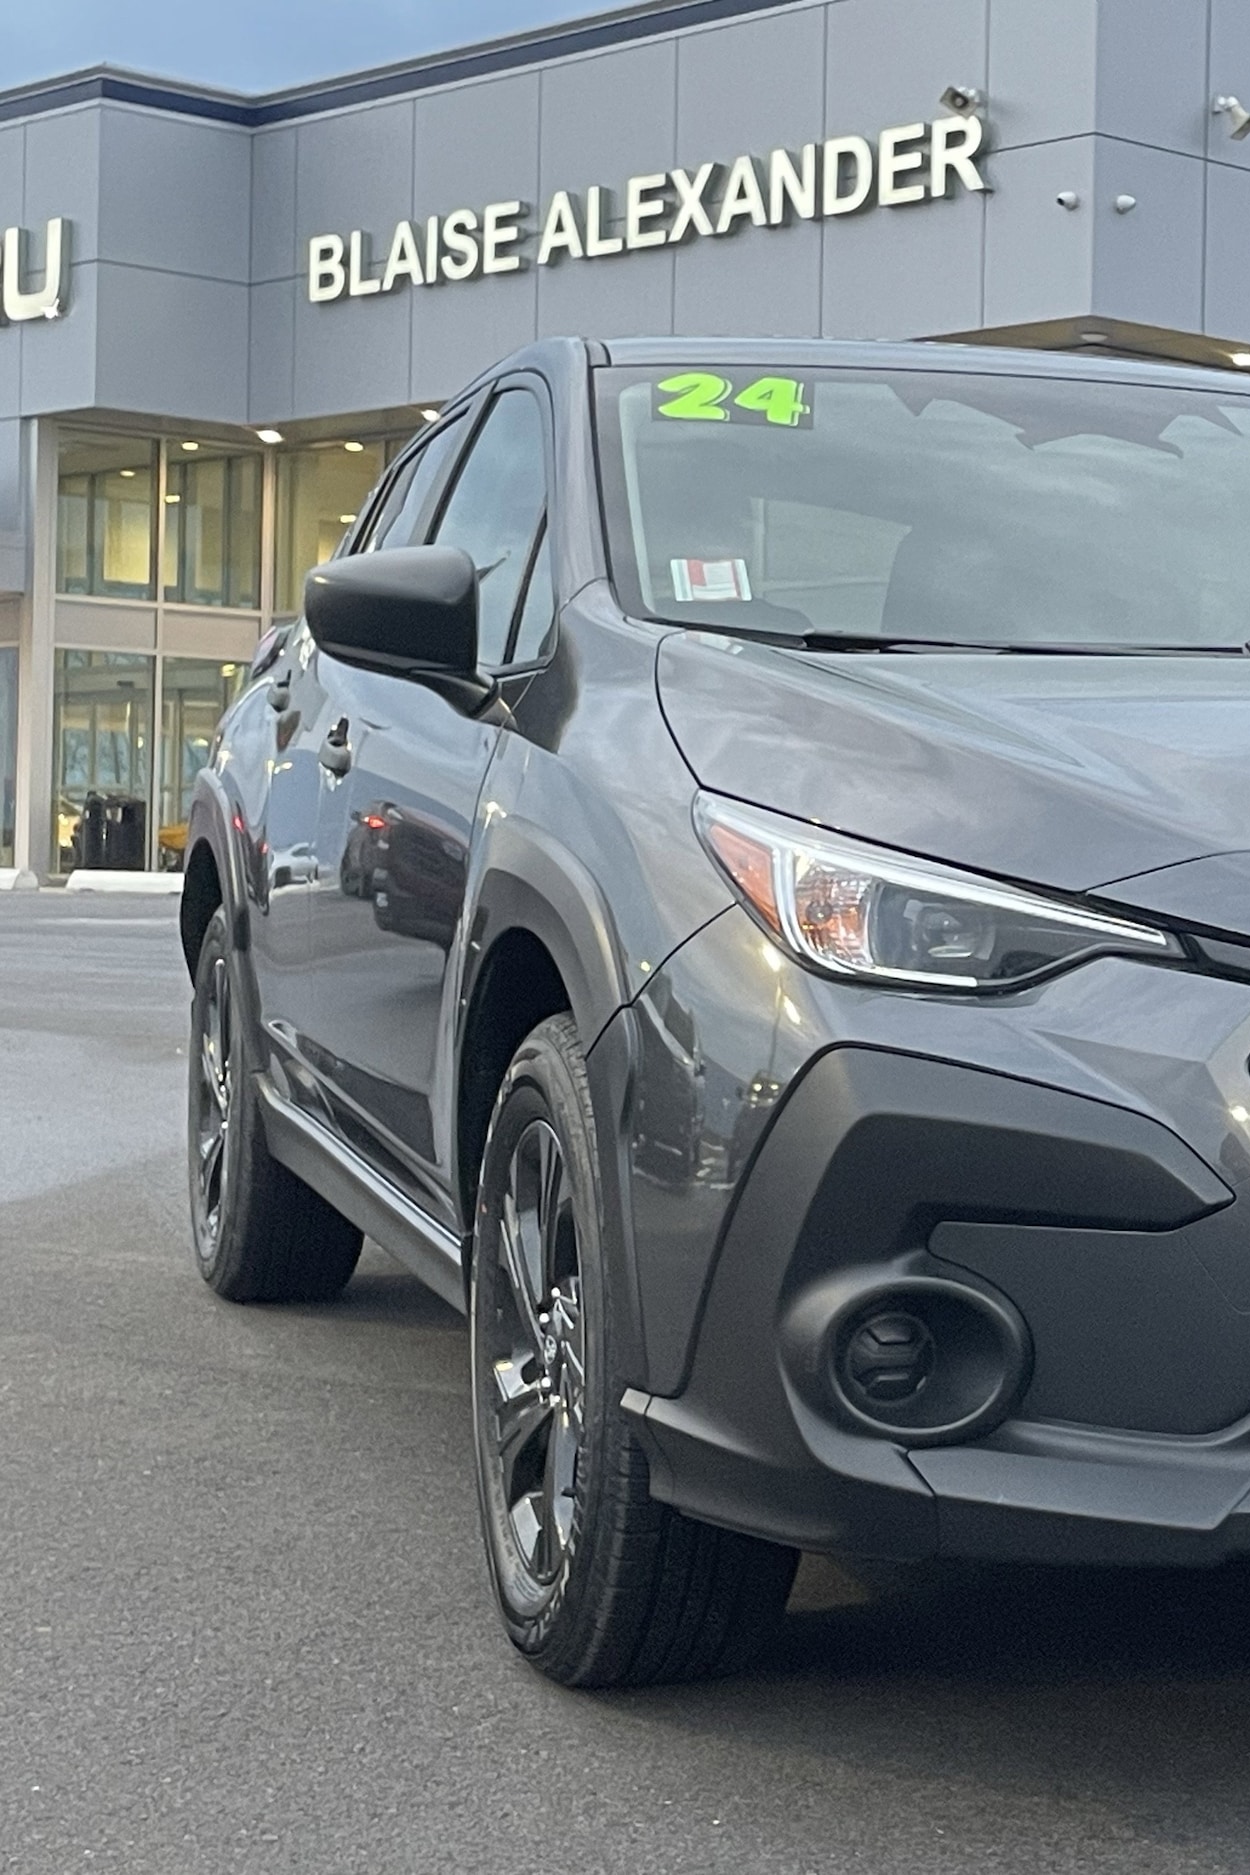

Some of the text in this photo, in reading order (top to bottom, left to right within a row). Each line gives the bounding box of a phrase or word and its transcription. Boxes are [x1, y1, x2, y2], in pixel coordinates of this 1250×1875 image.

[308, 114, 985, 303] BLAISE ALEXANDER
[0, 216, 66, 322] U
[657, 373, 811, 427] 24
